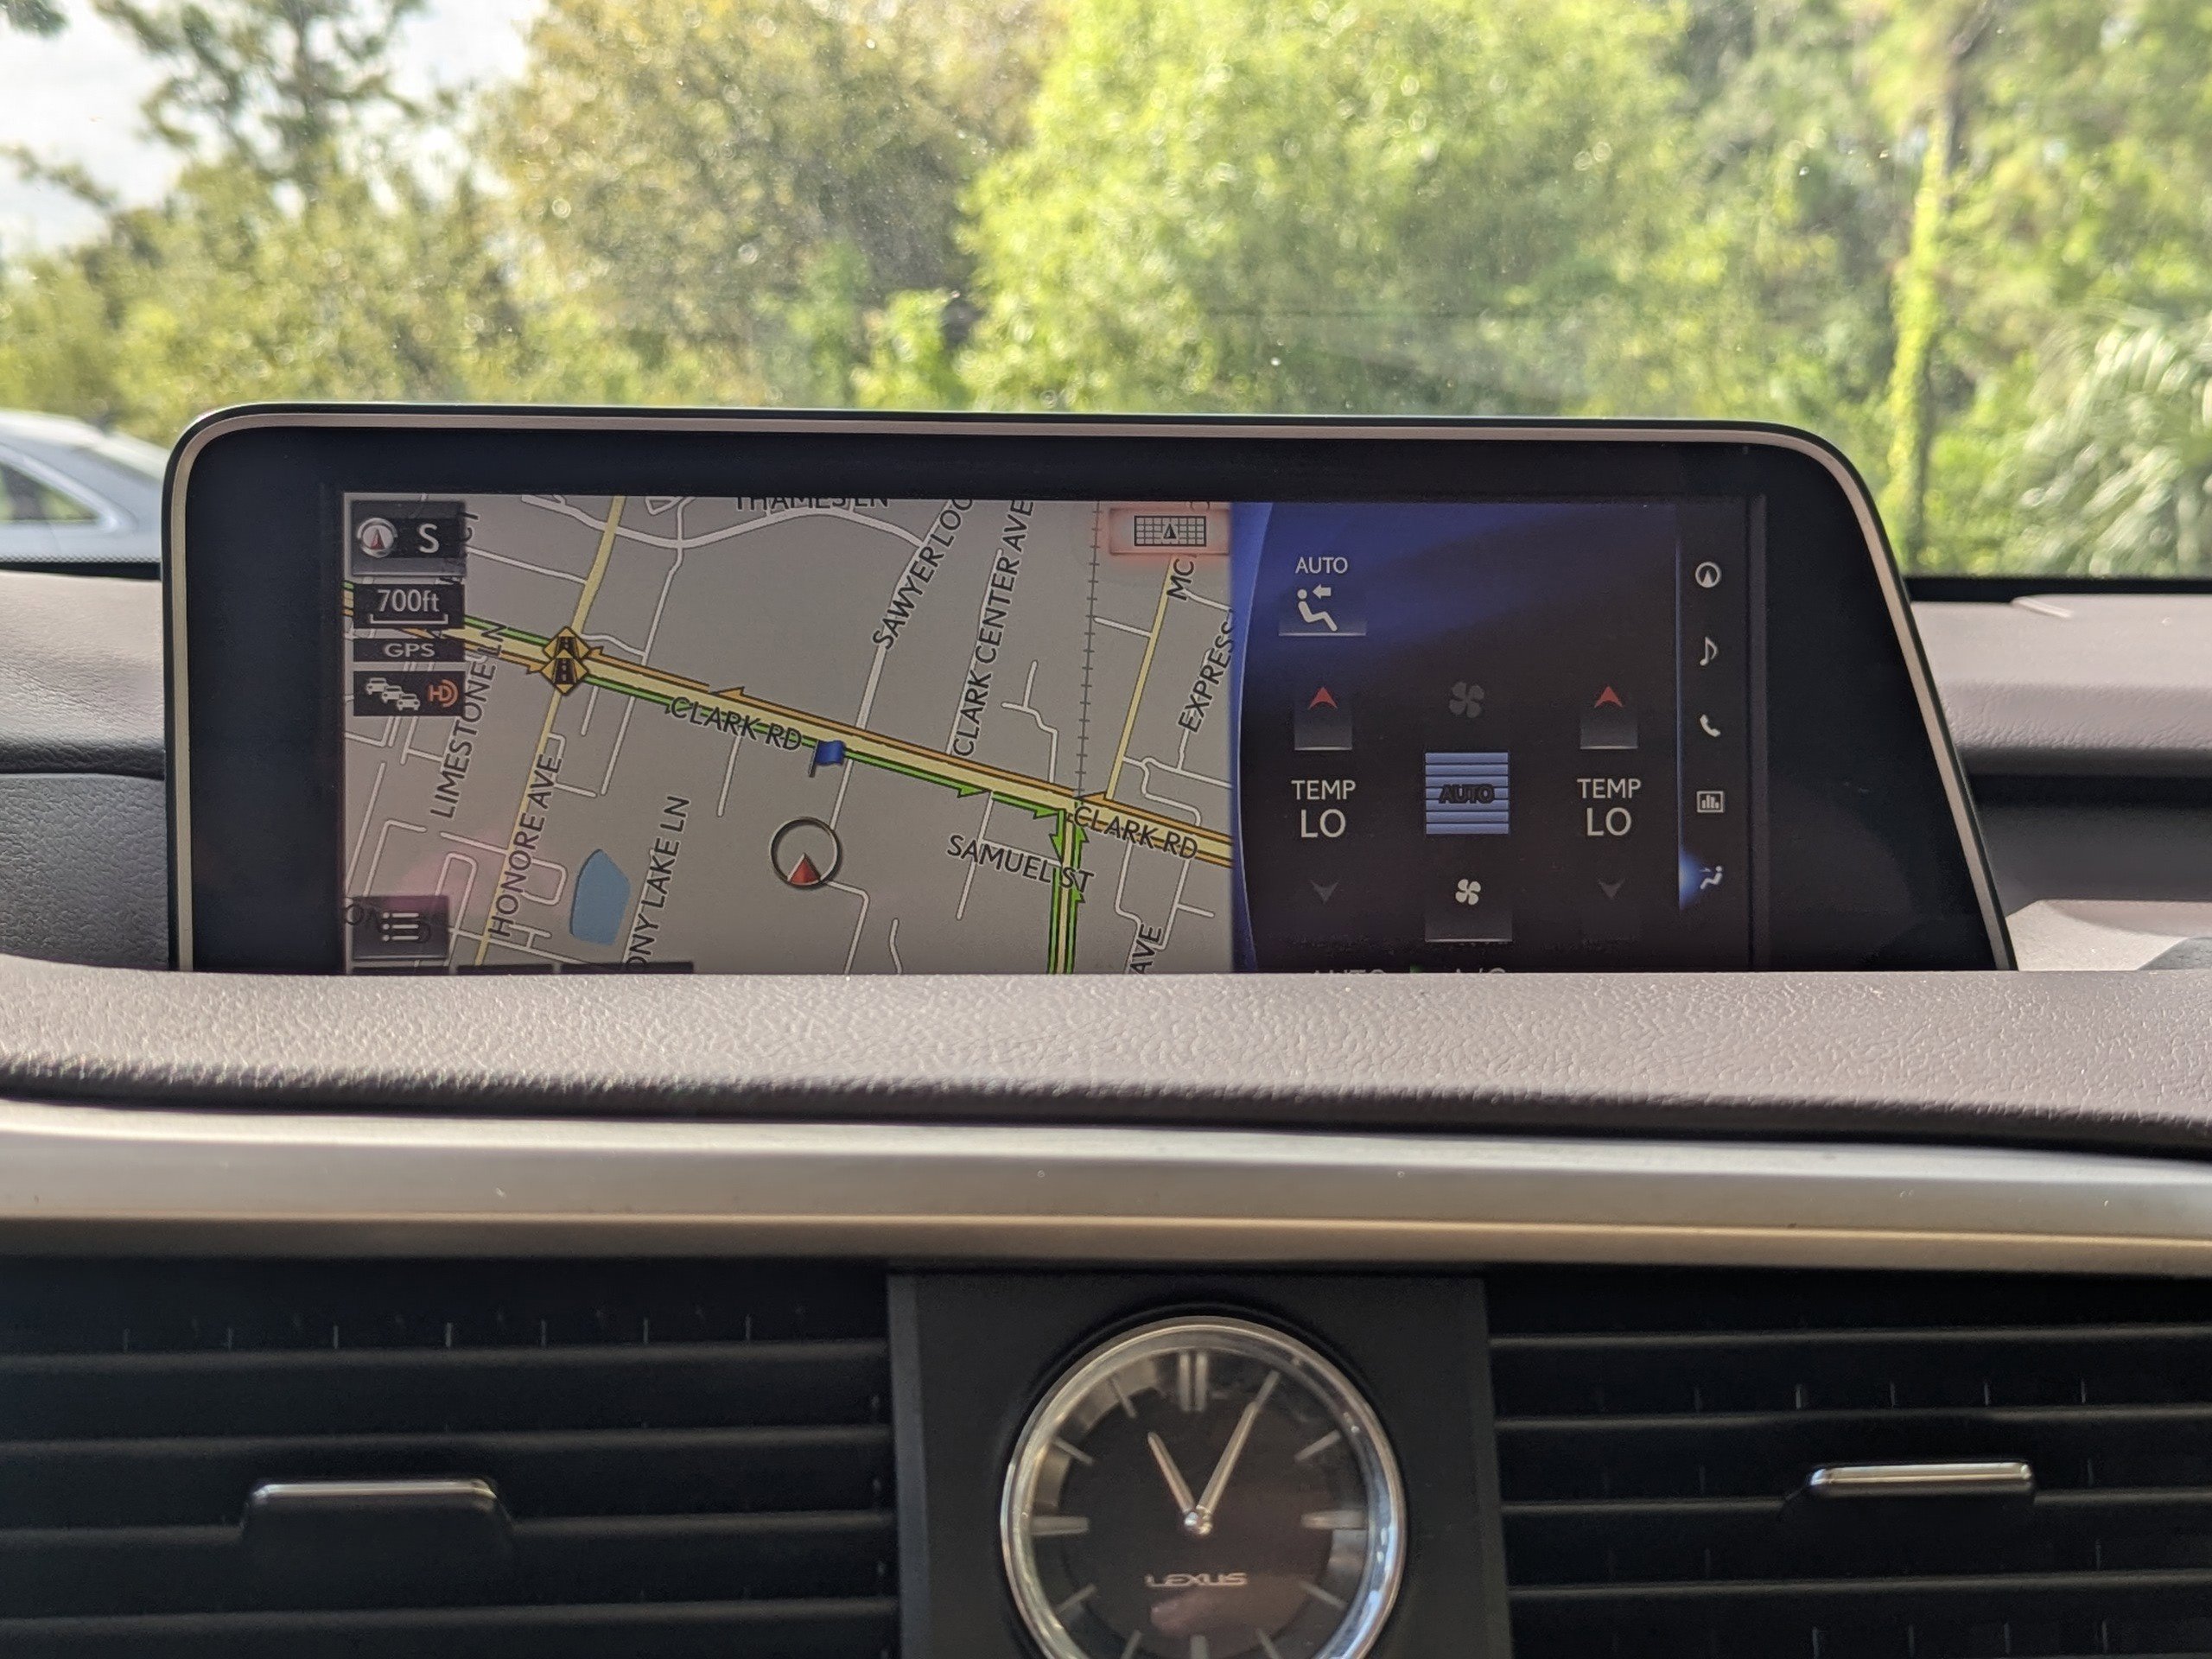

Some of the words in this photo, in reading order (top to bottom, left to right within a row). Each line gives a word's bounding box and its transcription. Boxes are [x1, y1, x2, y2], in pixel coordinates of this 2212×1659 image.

[418, 524, 439, 553] S
[1295, 556, 1349, 574] AUTO
[378, 588, 440, 612] 700ft
[872, 546, 944, 649] SAWYER
[952, 670, 992, 757] CLARK
[975, 556, 1020, 664] CENTER
[1002, 499, 1034, 552] AVE
[385, 643, 435, 658] GPS
[671, 696, 760, 741] CLARK
[766, 726, 802, 751] RD
[430, 661, 497, 819] LIMESTONE
[1292, 779, 1356, 800] TEMP
[1439, 784, 1496, 804] AUTO
[1577, 779, 1642, 799] TEMP
[660, 796, 690, 832] LN
[1300, 809, 1346, 838] LO
[1586, 807, 1632, 836] LO
[487, 812, 545, 938] HONORE
[528, 753, 562, 810] AVE
[1074, 806, 1160, 848] CLARK
[1163, 832, 1198, 859] RD
[641, 838, 680, 908] LAKE
[947, 835, 1052, 883] SAMUEL
[1059, 868, 1094, 893] ST
[1129, 924, 1162, 973] AVE
[1145, 1573, 1248, 1588] LEXUS
